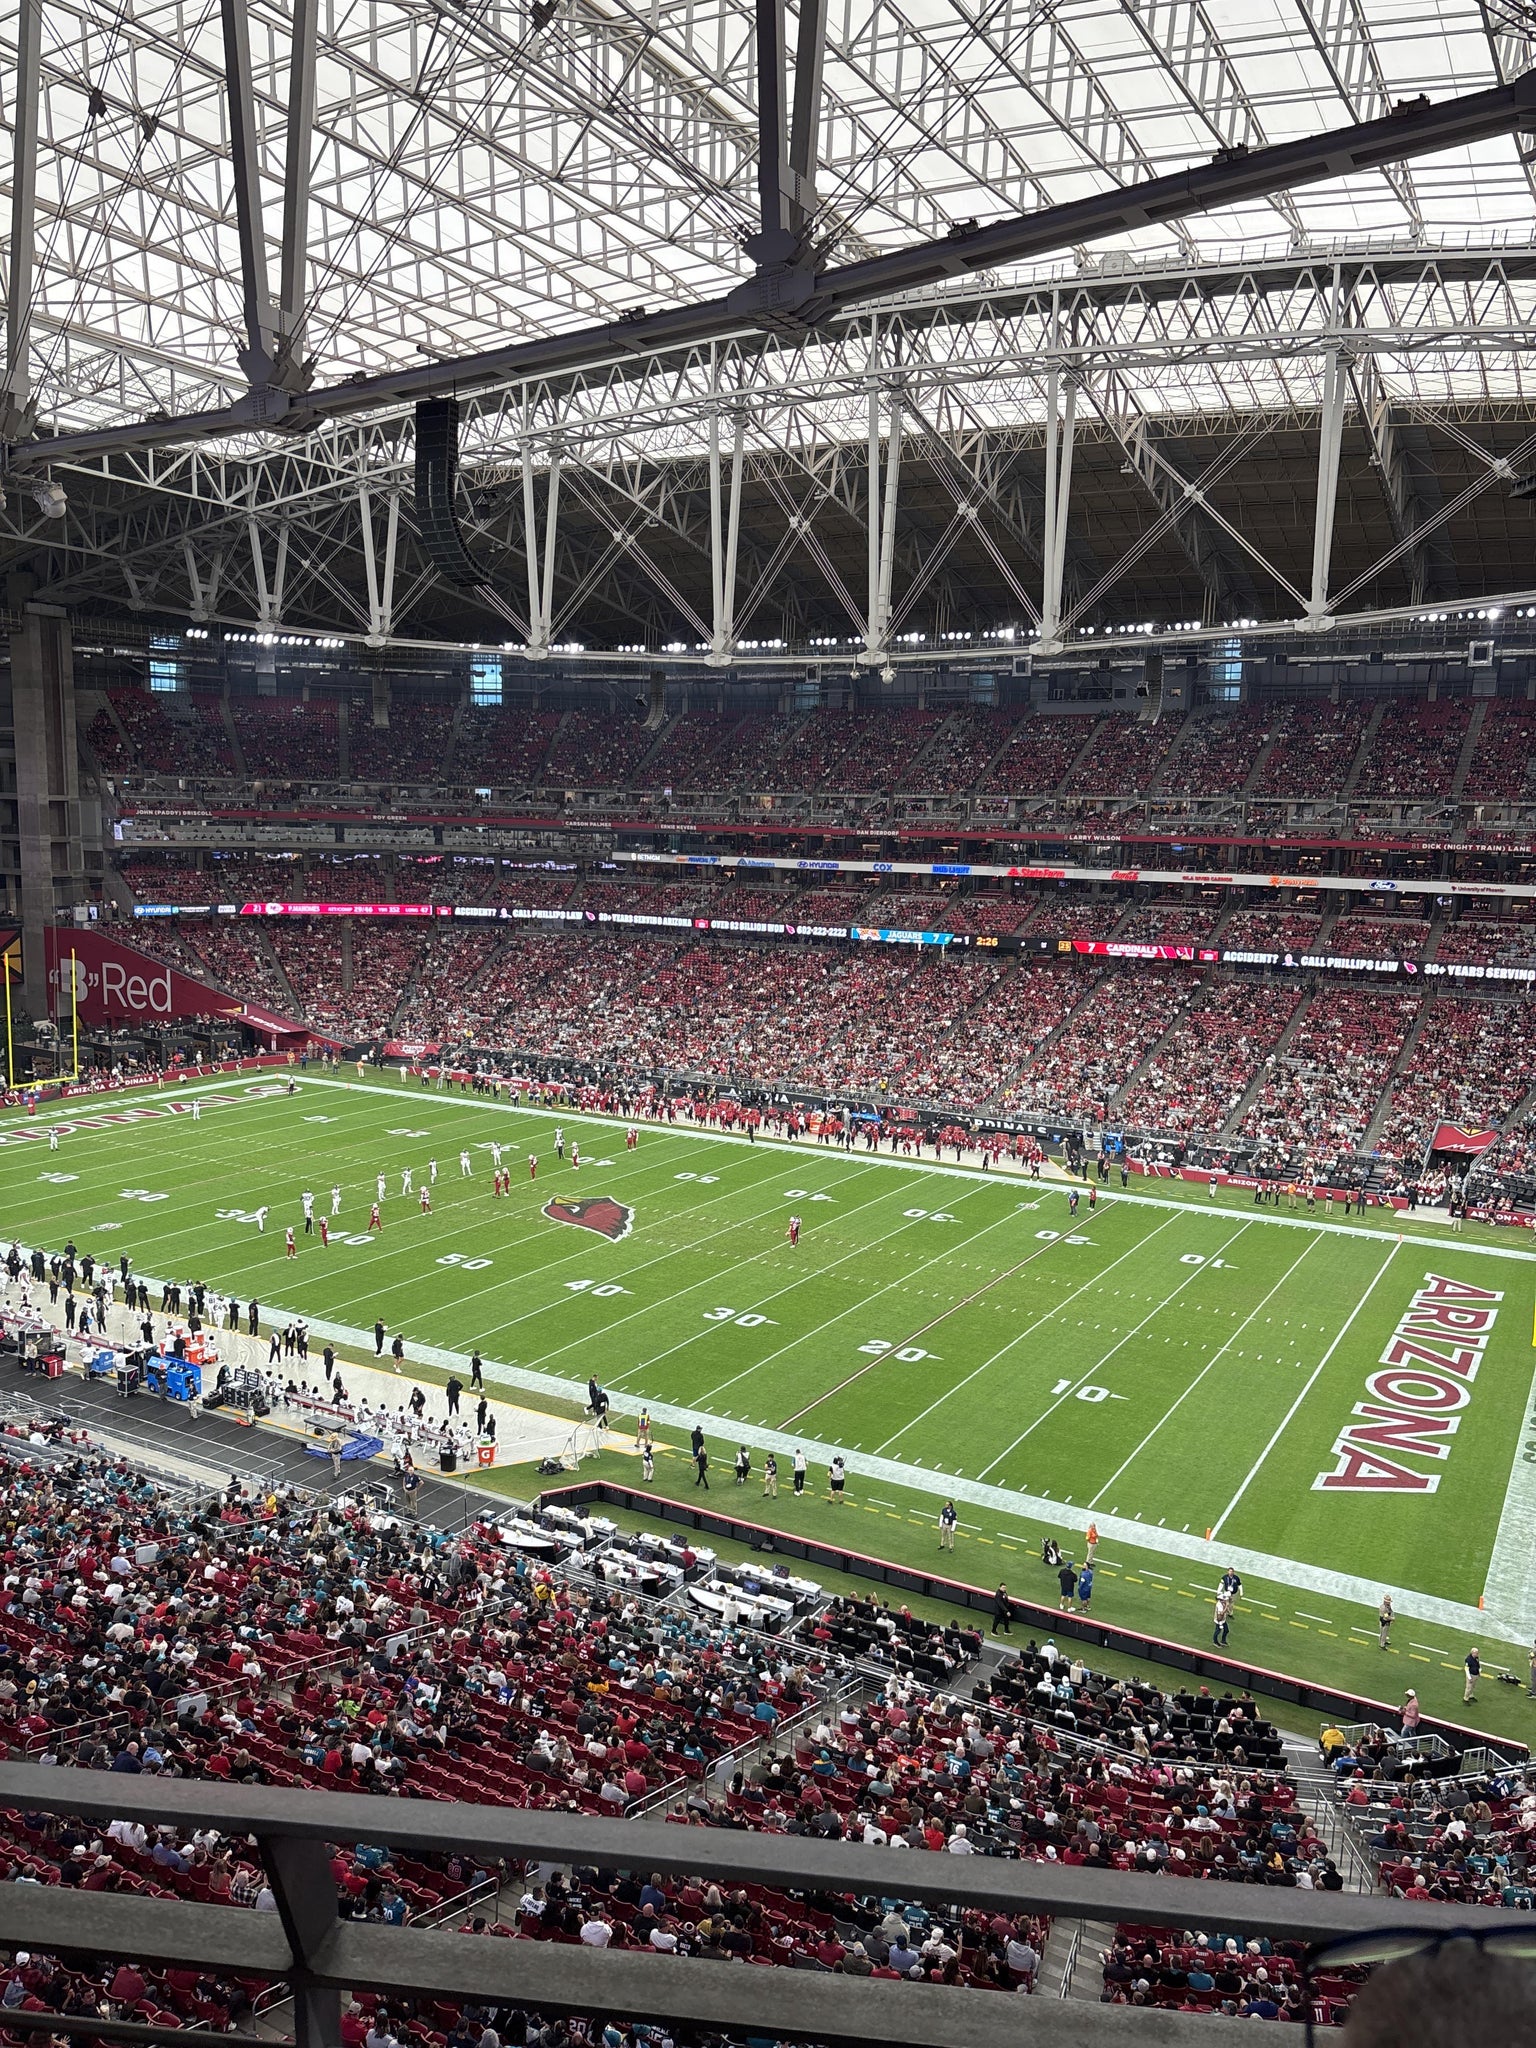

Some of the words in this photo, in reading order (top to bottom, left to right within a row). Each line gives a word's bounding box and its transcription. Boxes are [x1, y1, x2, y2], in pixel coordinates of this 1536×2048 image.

[455, 907, 497, 916] ACCIDENT?
[512, 909, 531, 918] CALL
[532, 910, 566, 919] PHILLIPS
[566, 911, 583, 920] LAW
[711, 920, 729, 929] OVER
[796, 926, 847, 937] 602-222-2222
[888, 931, 923, 939] JAGUARS
[976, 936, 998, 946] 2:26
[1088, 943, 1095, 952] 7
[1106, 944, 1158, 954] CARDINALS
[1223, 951, 1279, 964] ACCIDENT?
[1301, 956, 1326, 967] CALL
[1327, 957, 1374, 971] PHILLIPS
[1375, 960, 1399, 972] LAW
[1424, 964, 1446, 974] 30+
[1448, 965, 1485, 978] YEARS
[1486, 967, 1536, 981] SERVING
[102, 962, 172, 1012] Red
[109, 1076, 154, 1088] CADINALS
[673, 1172, 720, 1184] 50
[1227, 1178, 1258, 1187] ARIZON
[118, 1189, 170, 1202] 20
[783, 1189, 831, 1202] 40
[902, 1208, 955, 1222] 30
[1034, 1230, 1090, 1244] 20
[435, 1253, 493, 1270] 50
[1179, 1254, 1225, 1269] 10
[564, 1279, 624, 1296] 40
[703, 1307, 767, 1327] 30
[857, 1340, 928, 1362] 20
[1310, 1272, 1505, 1494] ARIZONA
[1050, 1379, 1110, 1403] 10
[482, 1450, 490, 1459] G
[949, 1763, 959, 1775] 16
[1314, 2008, 1323, 2022] 11
